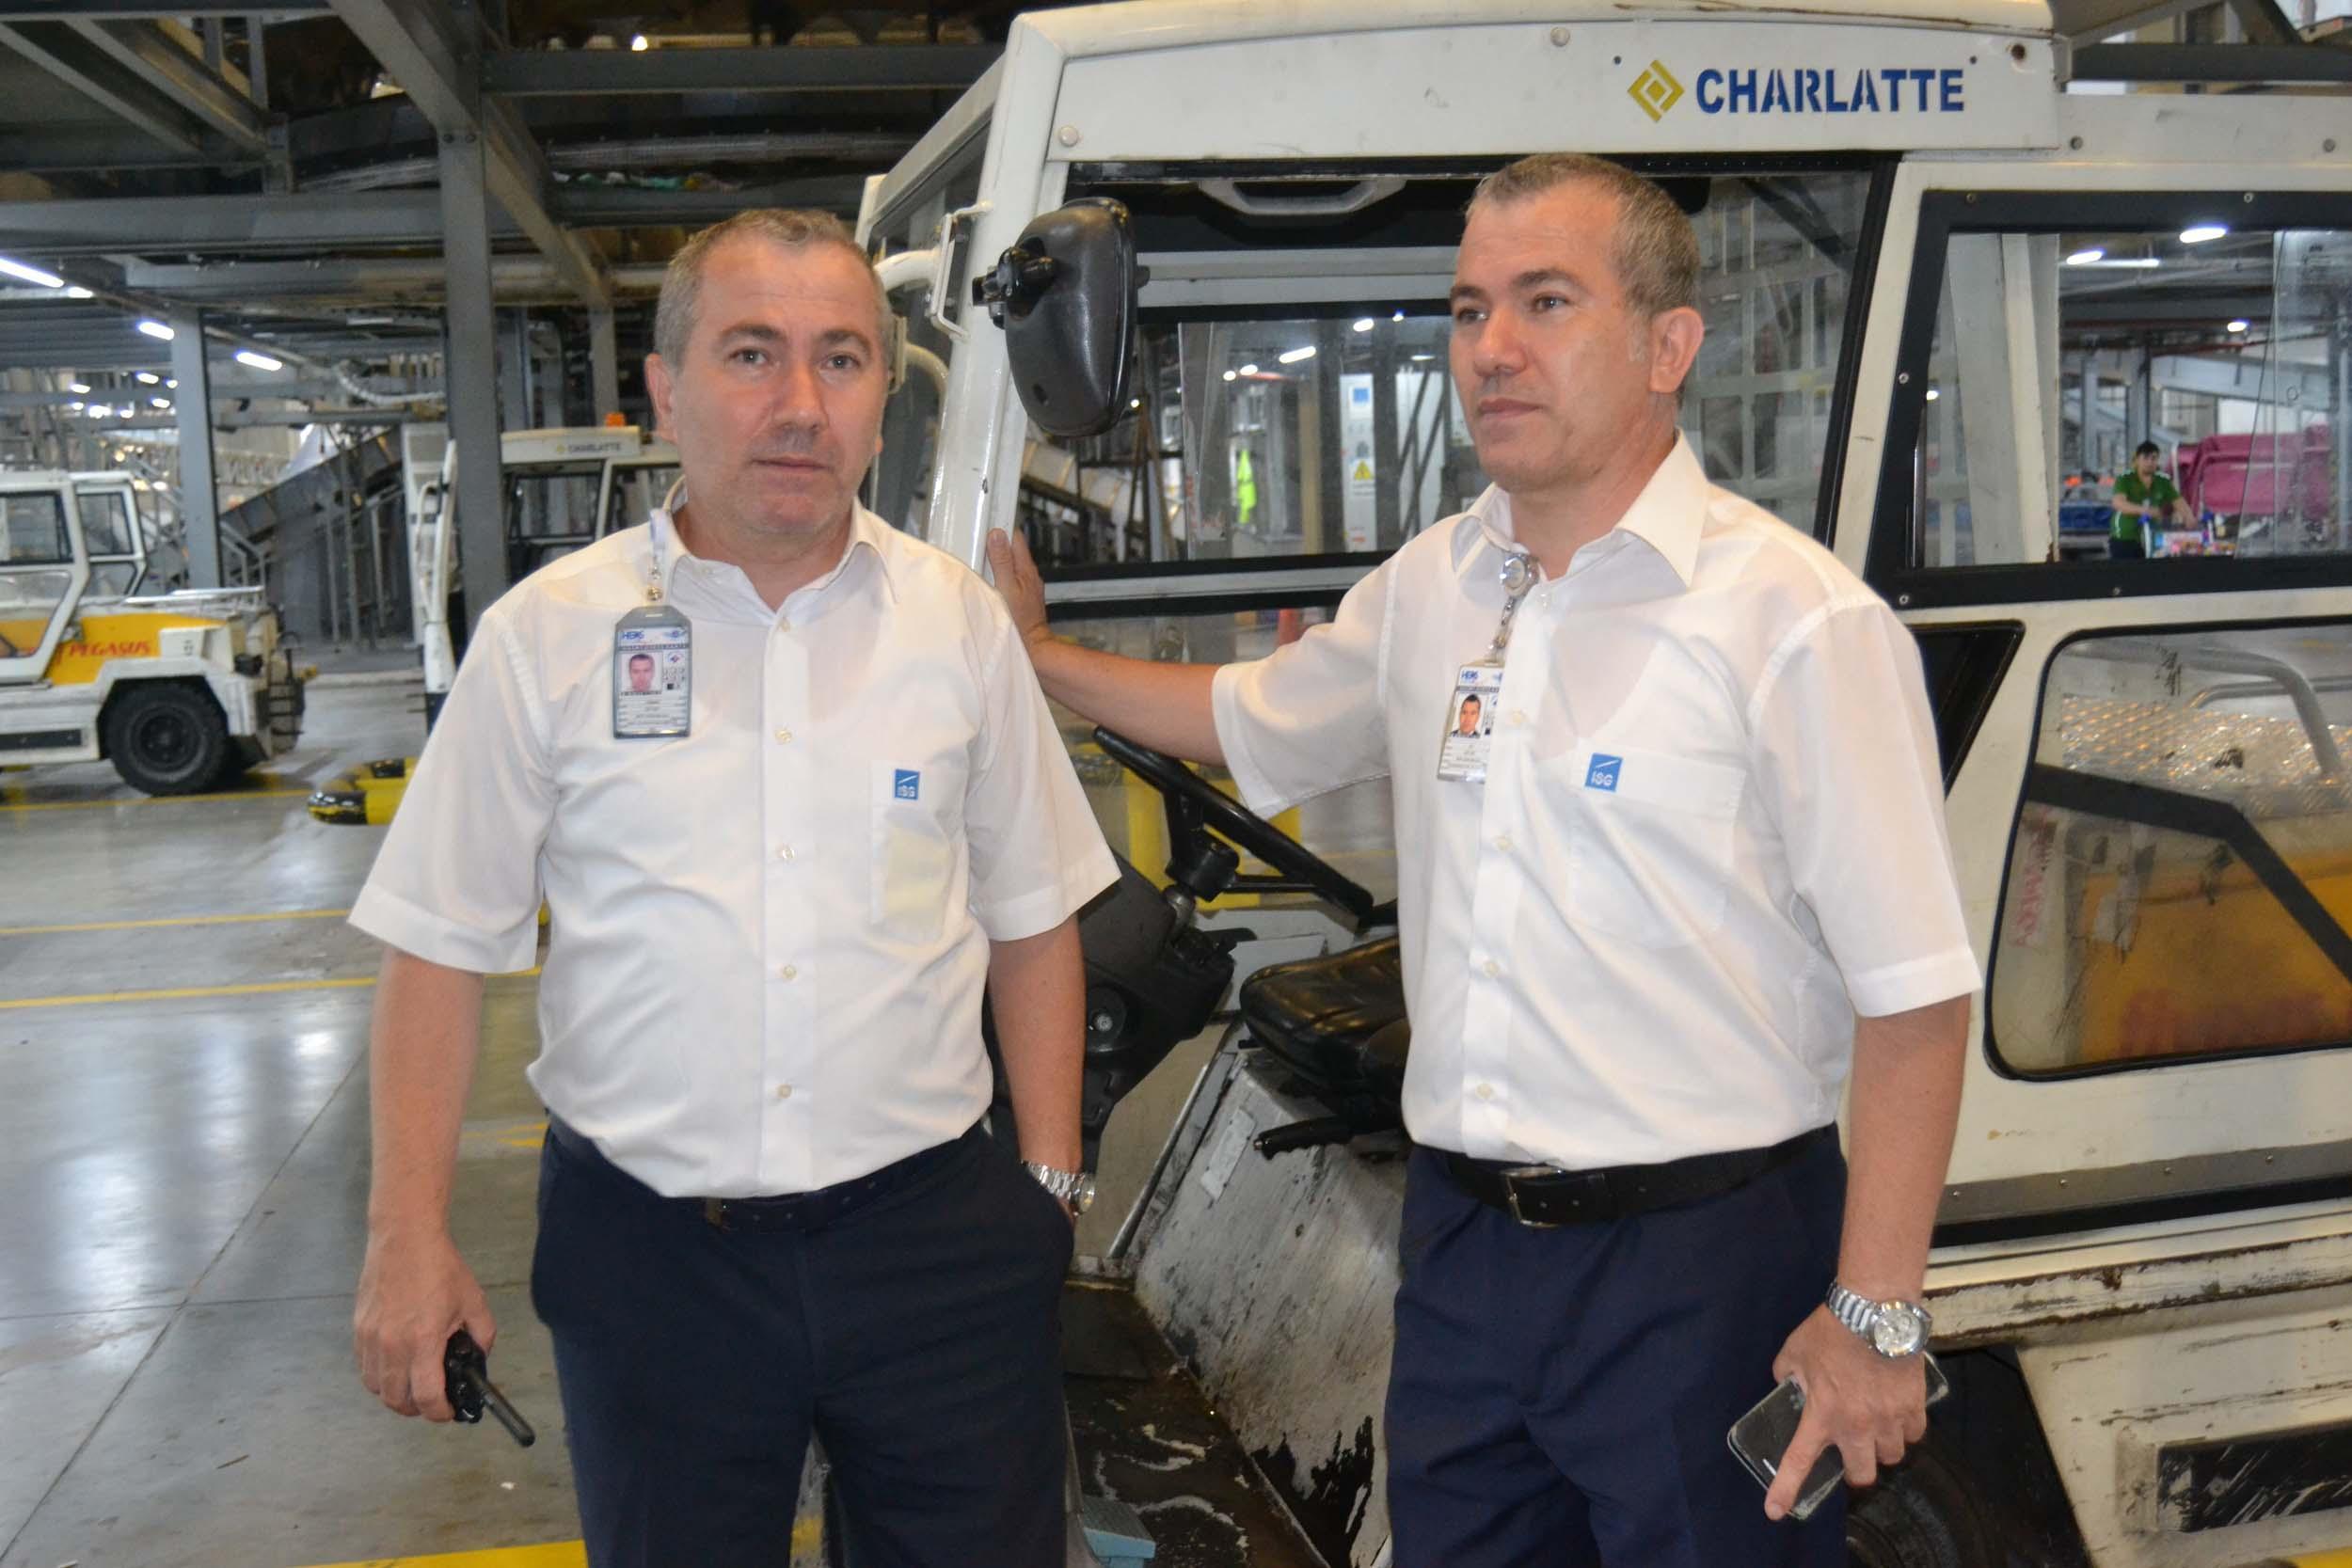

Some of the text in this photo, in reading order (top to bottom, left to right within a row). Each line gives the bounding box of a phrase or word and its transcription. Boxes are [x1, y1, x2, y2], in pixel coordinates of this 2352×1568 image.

[1695, 68, 1964, 114] CHARLATTE
[69, 641, 151, 657] PEGASUS
[1591, 771, 1613, 786] ISG
